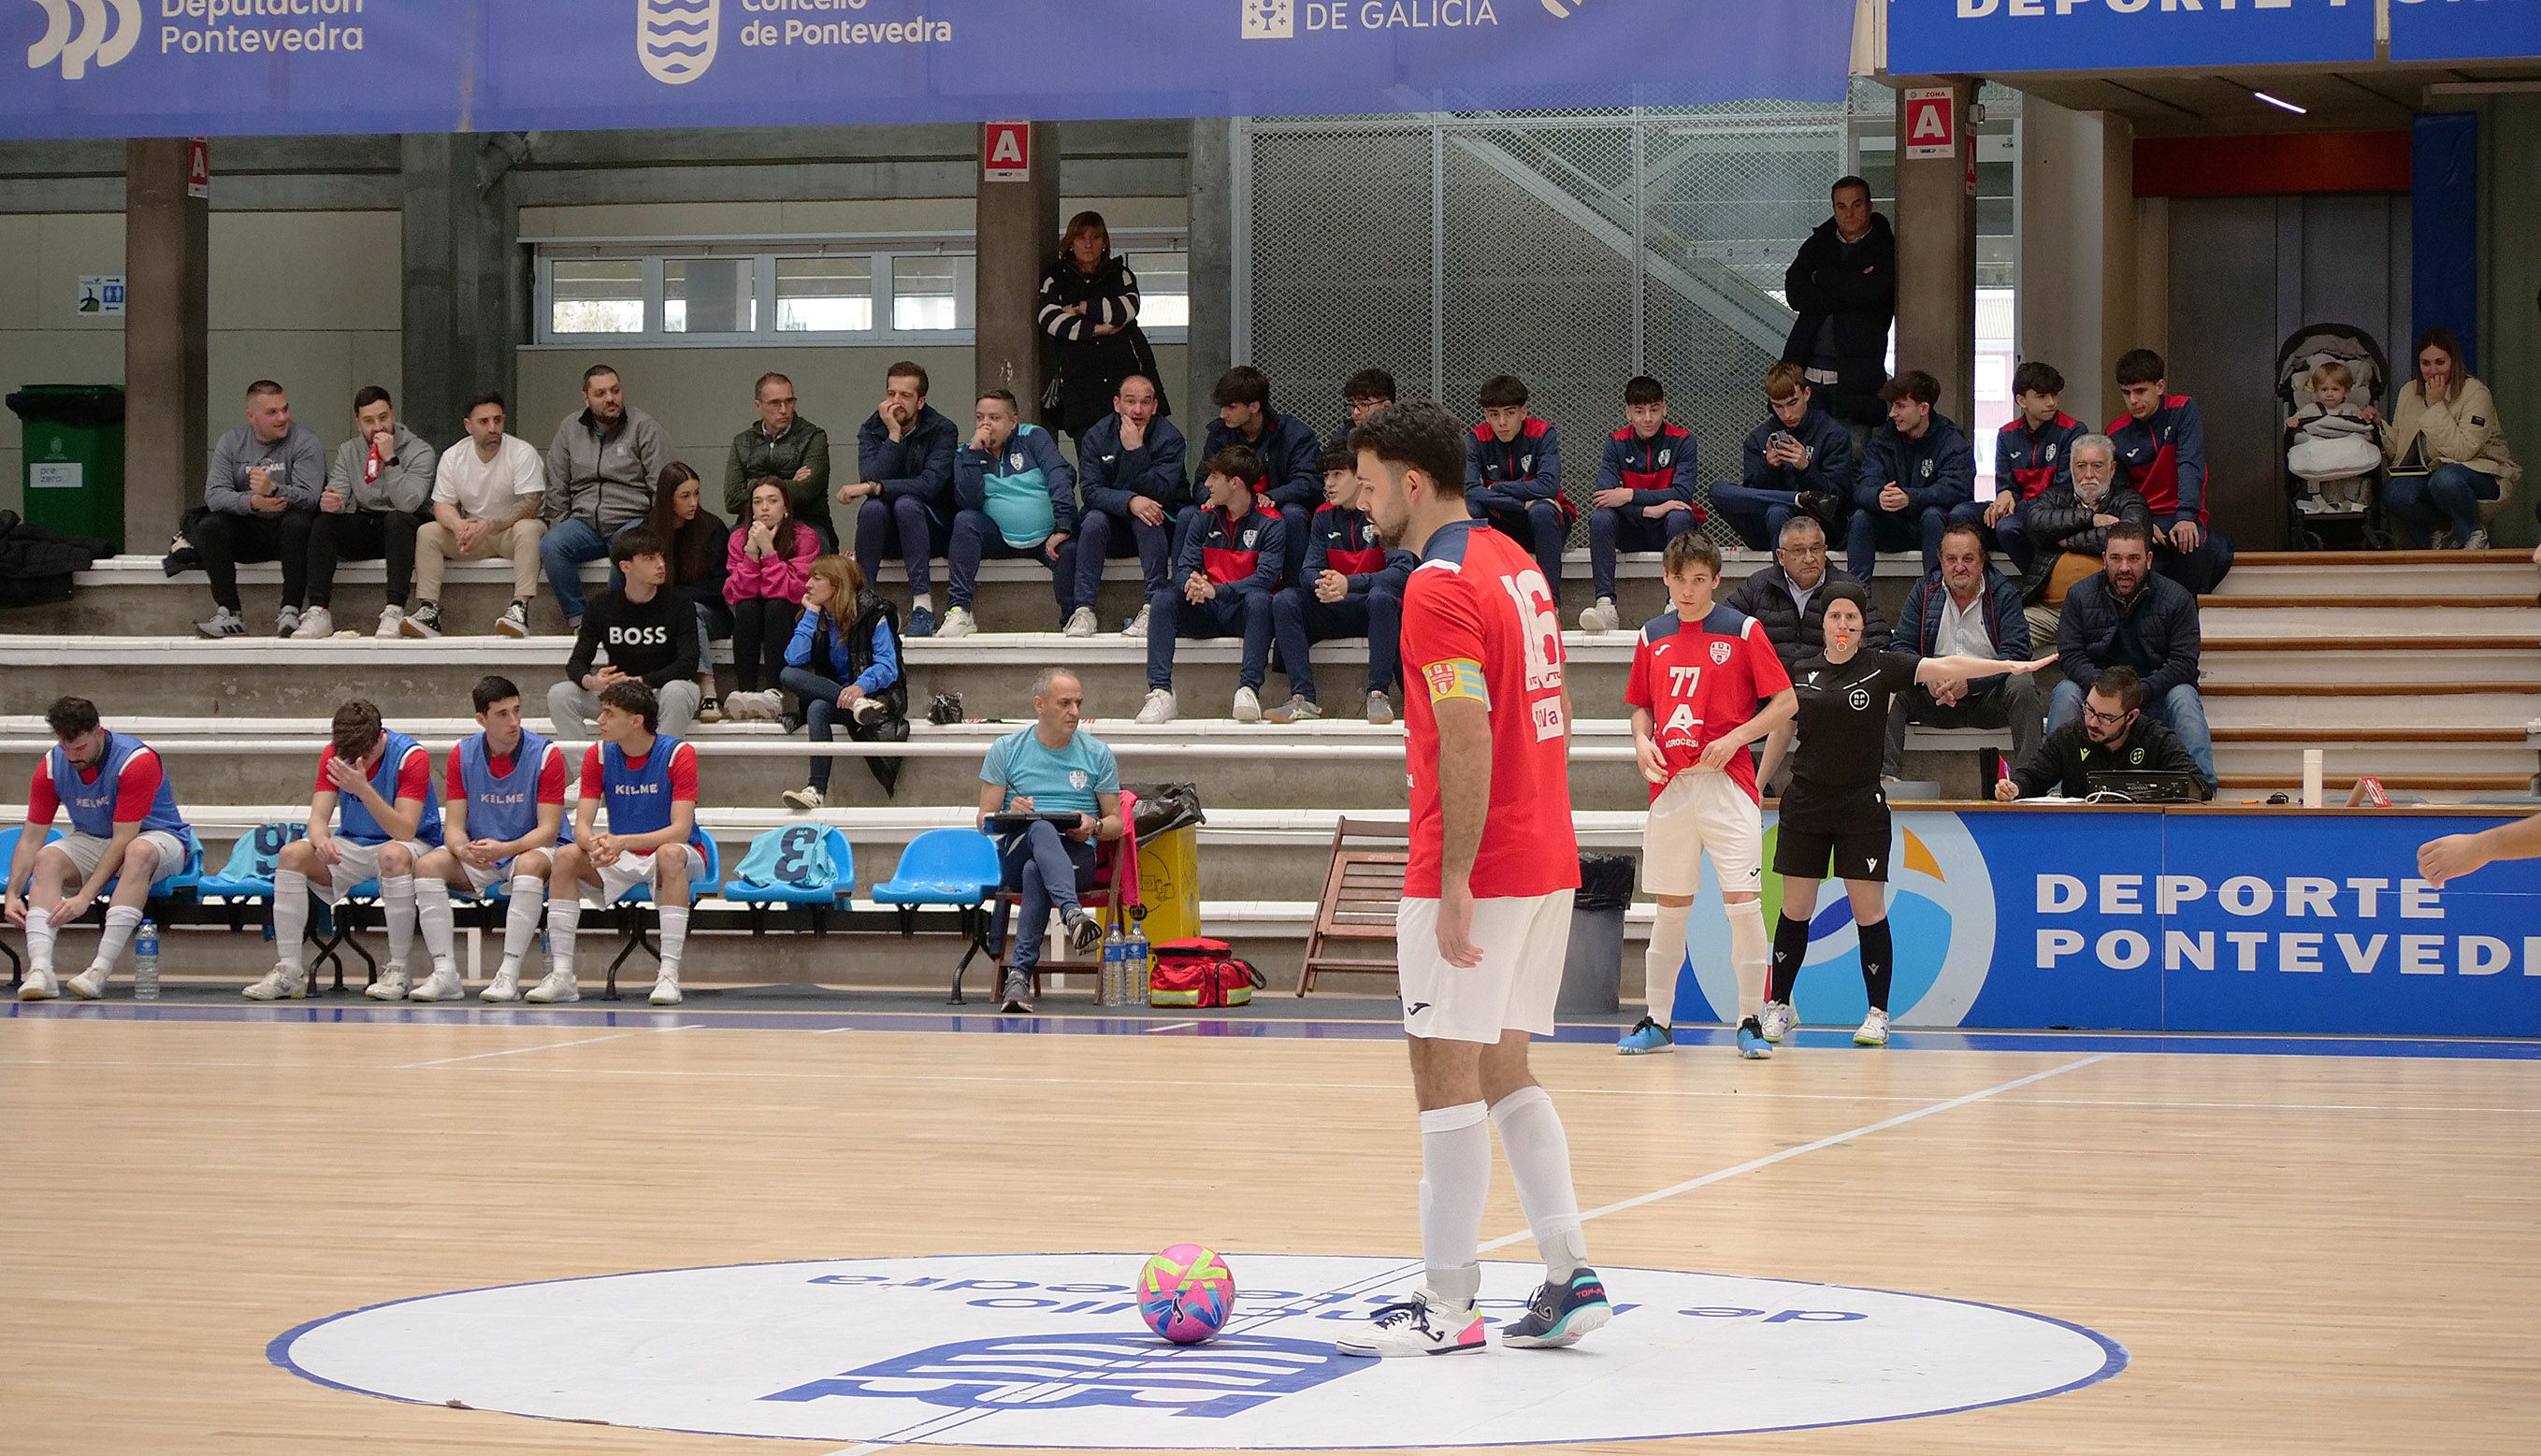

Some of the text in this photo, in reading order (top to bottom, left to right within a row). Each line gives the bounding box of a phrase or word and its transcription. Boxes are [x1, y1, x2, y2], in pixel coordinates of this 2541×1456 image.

[740, 15, 952, 46] de Pontevedra
[1307, 0, 1498, 30] DE GALICIA
[161, 22, 363, 54] Pontevedra
[1913, 105, 1945, 138] A
[991, 130, 1022, 162] A
[1967, 142, 1975, 175] A
[192, 147, 205, 178] A
[609, 626, 668, 645] BOSS
[1499, 569, 1562, 692] 16
[1669, 666, 1701, 698] 77
[773, 828, 818, 882] 3
[2036, 873, 2445, 919] DEPORTE
[1676, 1305, 1869, 1323] de
